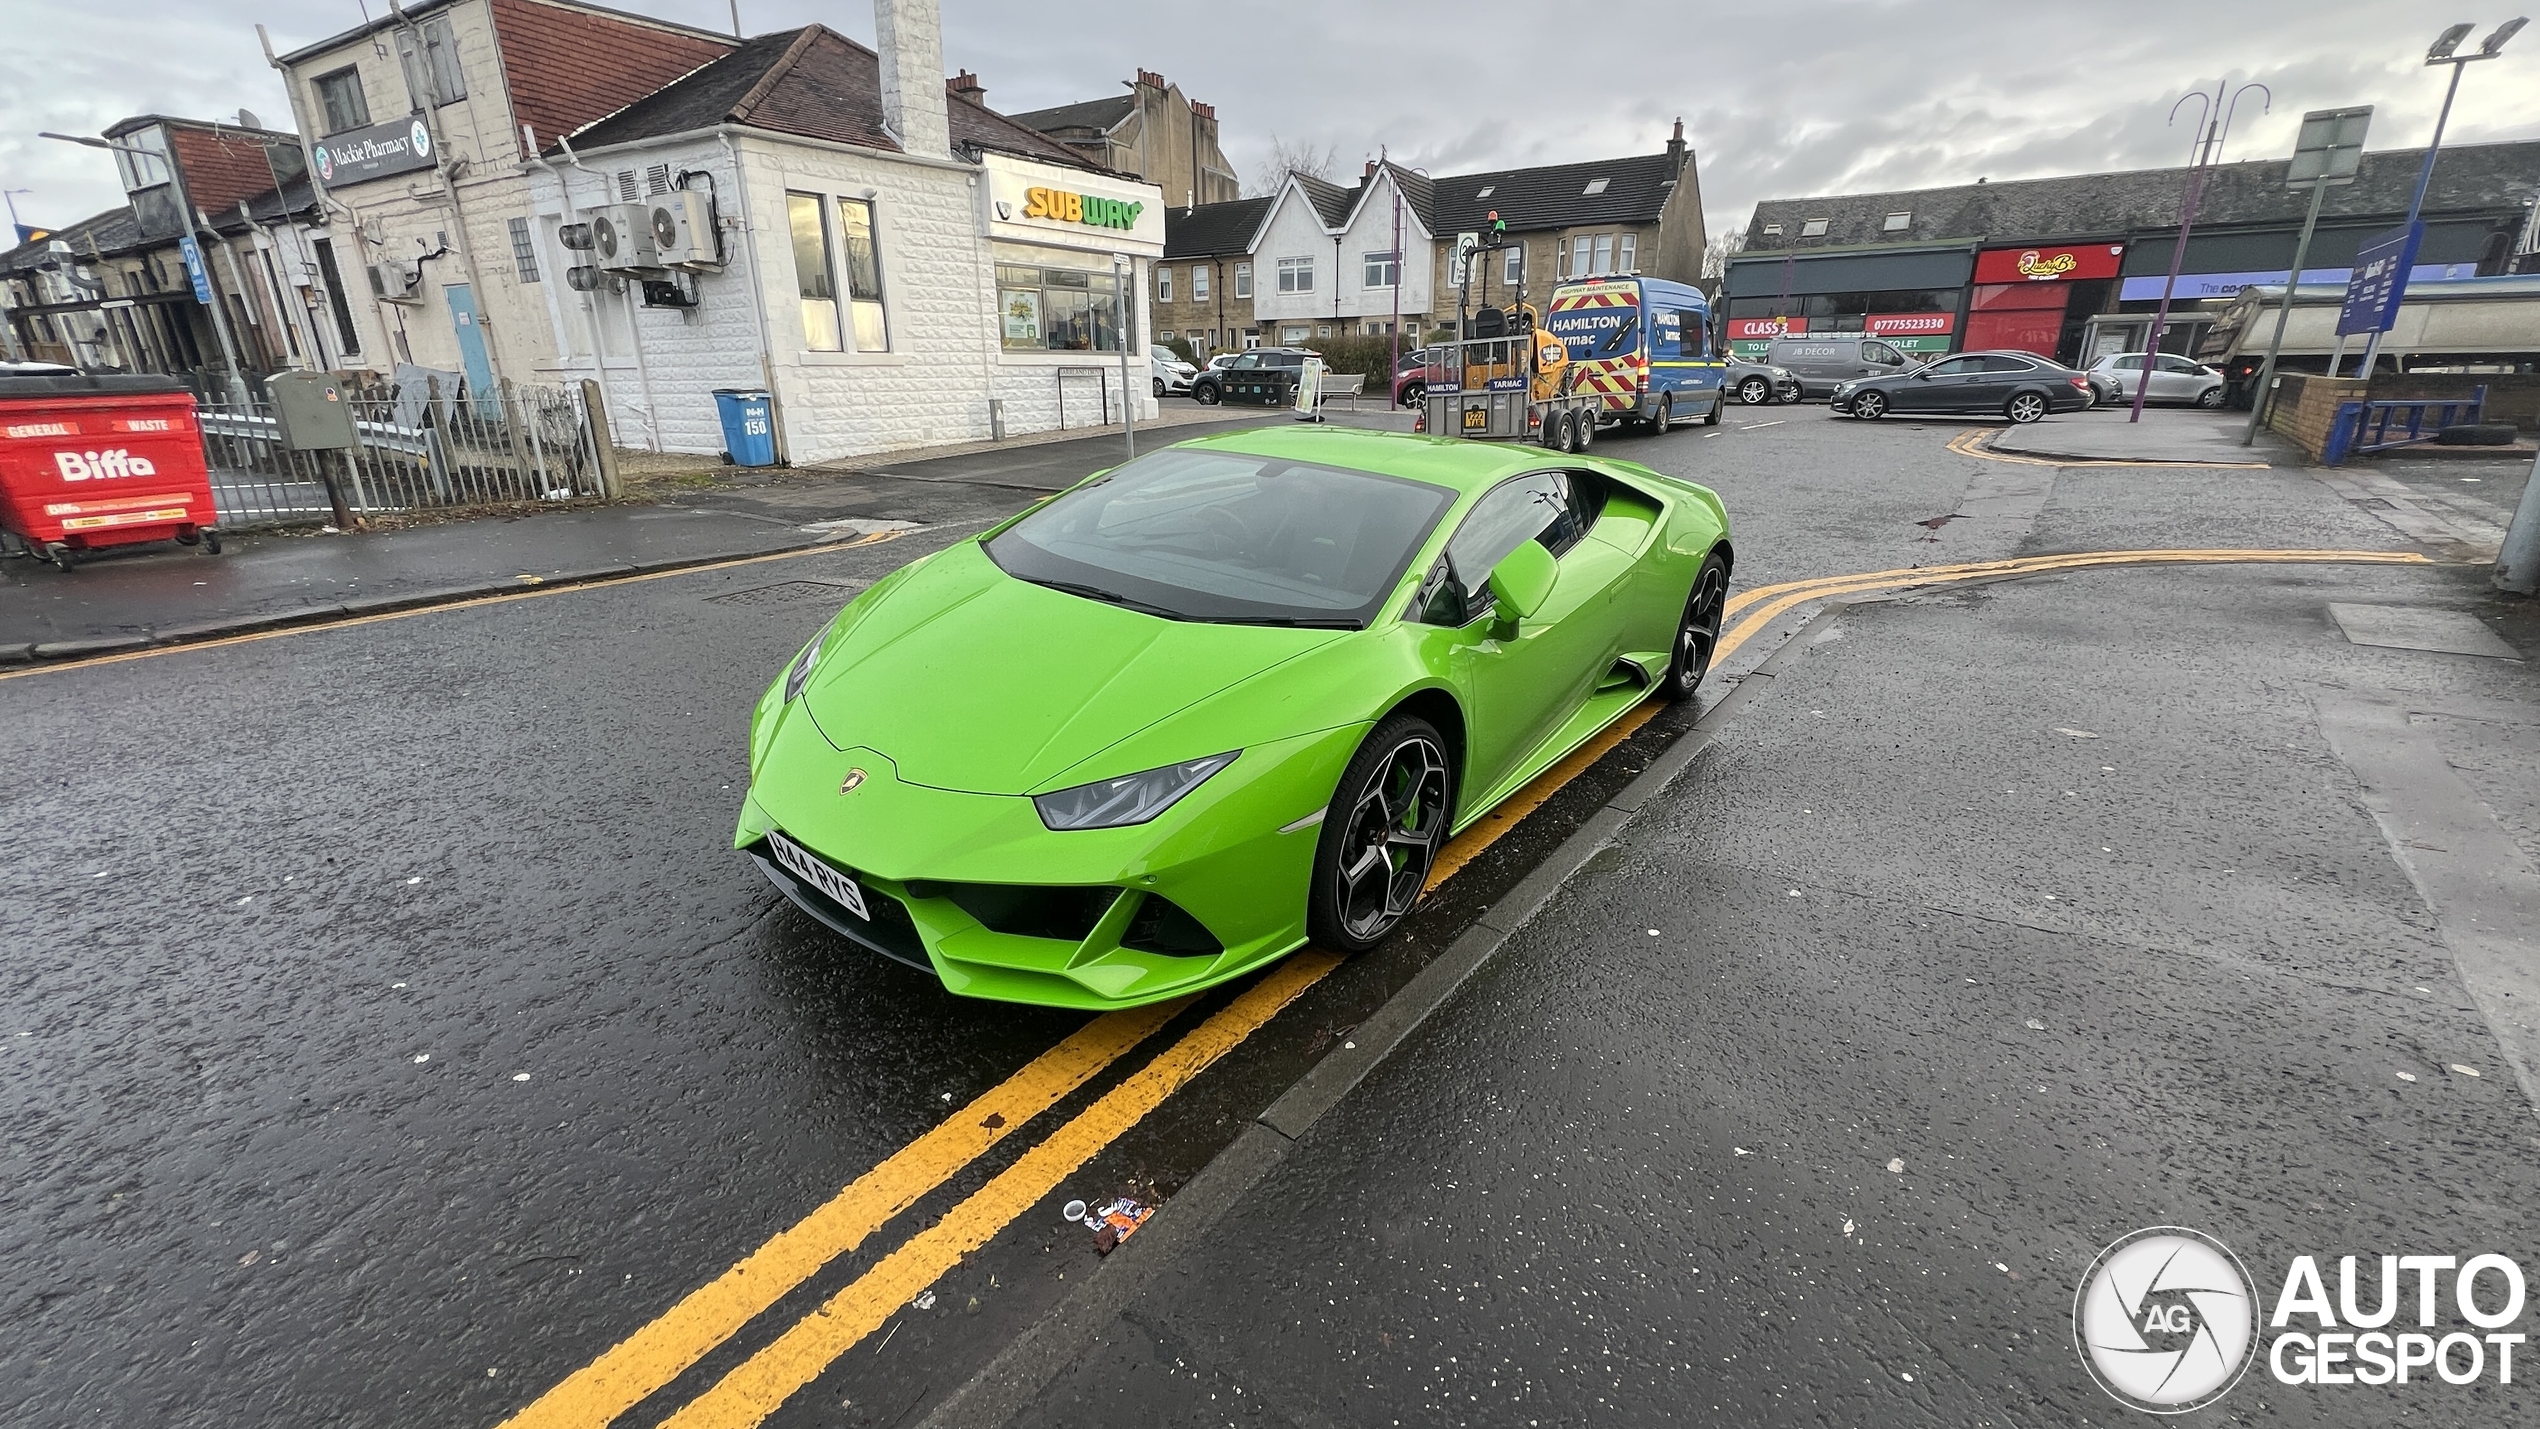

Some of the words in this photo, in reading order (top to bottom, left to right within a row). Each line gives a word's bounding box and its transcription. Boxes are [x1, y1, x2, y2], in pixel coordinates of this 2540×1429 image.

[331, 145, 365, 167] Mackie
[363, 136, 409, 156] Pharmacy
[1021, 186, 1144, 230] SUBWAY
[1561, 287, 1586, 295] HIGHWAY
[1587, 283, 1630, 292] MAINTENANCE
[2200, 283, 2219, 294] The
[1552, 315, 1621, 332] HAMILTON
[1657, 313, 1680, 326] HAMILTON
[1874, 318, 1944, 331] 07775523330
[1744, 321, 1780, 335] CLASS
[1780, 320, 1788, 334] 3
[1557, 333, 1596, 345] armac
[1887, 340, 1900, 348] TO
[1901, 339, 1919, 348] LET
[1747, 343, 1760, 351] TO
[1793, 347, 1803, 356] JB
[1804, 347, 1836, 356] DECOR
[1427, 383, 1459, 392] HAMILTON
[1493, 379, 1523, 389] TARMAC
[7, 423, 69, 438] GENERAL
[127, 420, 169, 432] WASTE
[745, 421, 767, 436] 150
[54, 449, 156, 482] Biffa
[769, 833, 813, 881] H44
[812, 861, 862, 912] RYS
